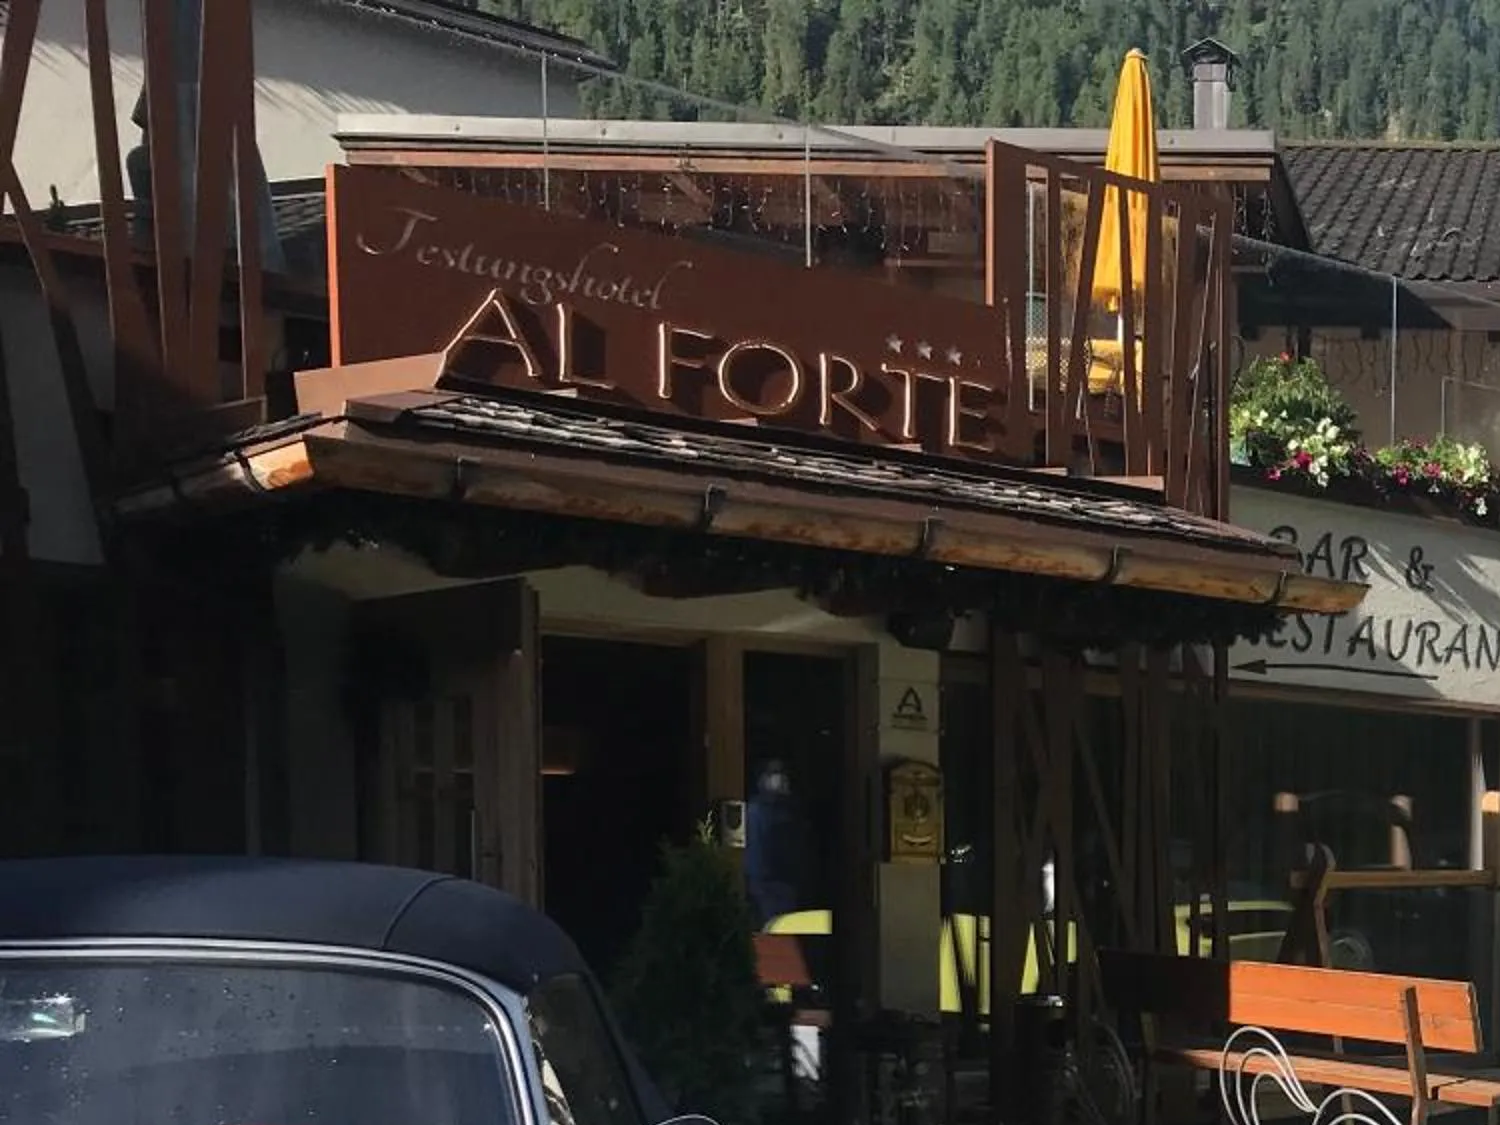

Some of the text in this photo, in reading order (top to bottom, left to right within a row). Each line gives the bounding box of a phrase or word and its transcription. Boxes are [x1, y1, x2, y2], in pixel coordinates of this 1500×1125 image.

[434, 288, 993, 452] AL FORTE
[1405, 546, 1435, 592] &
